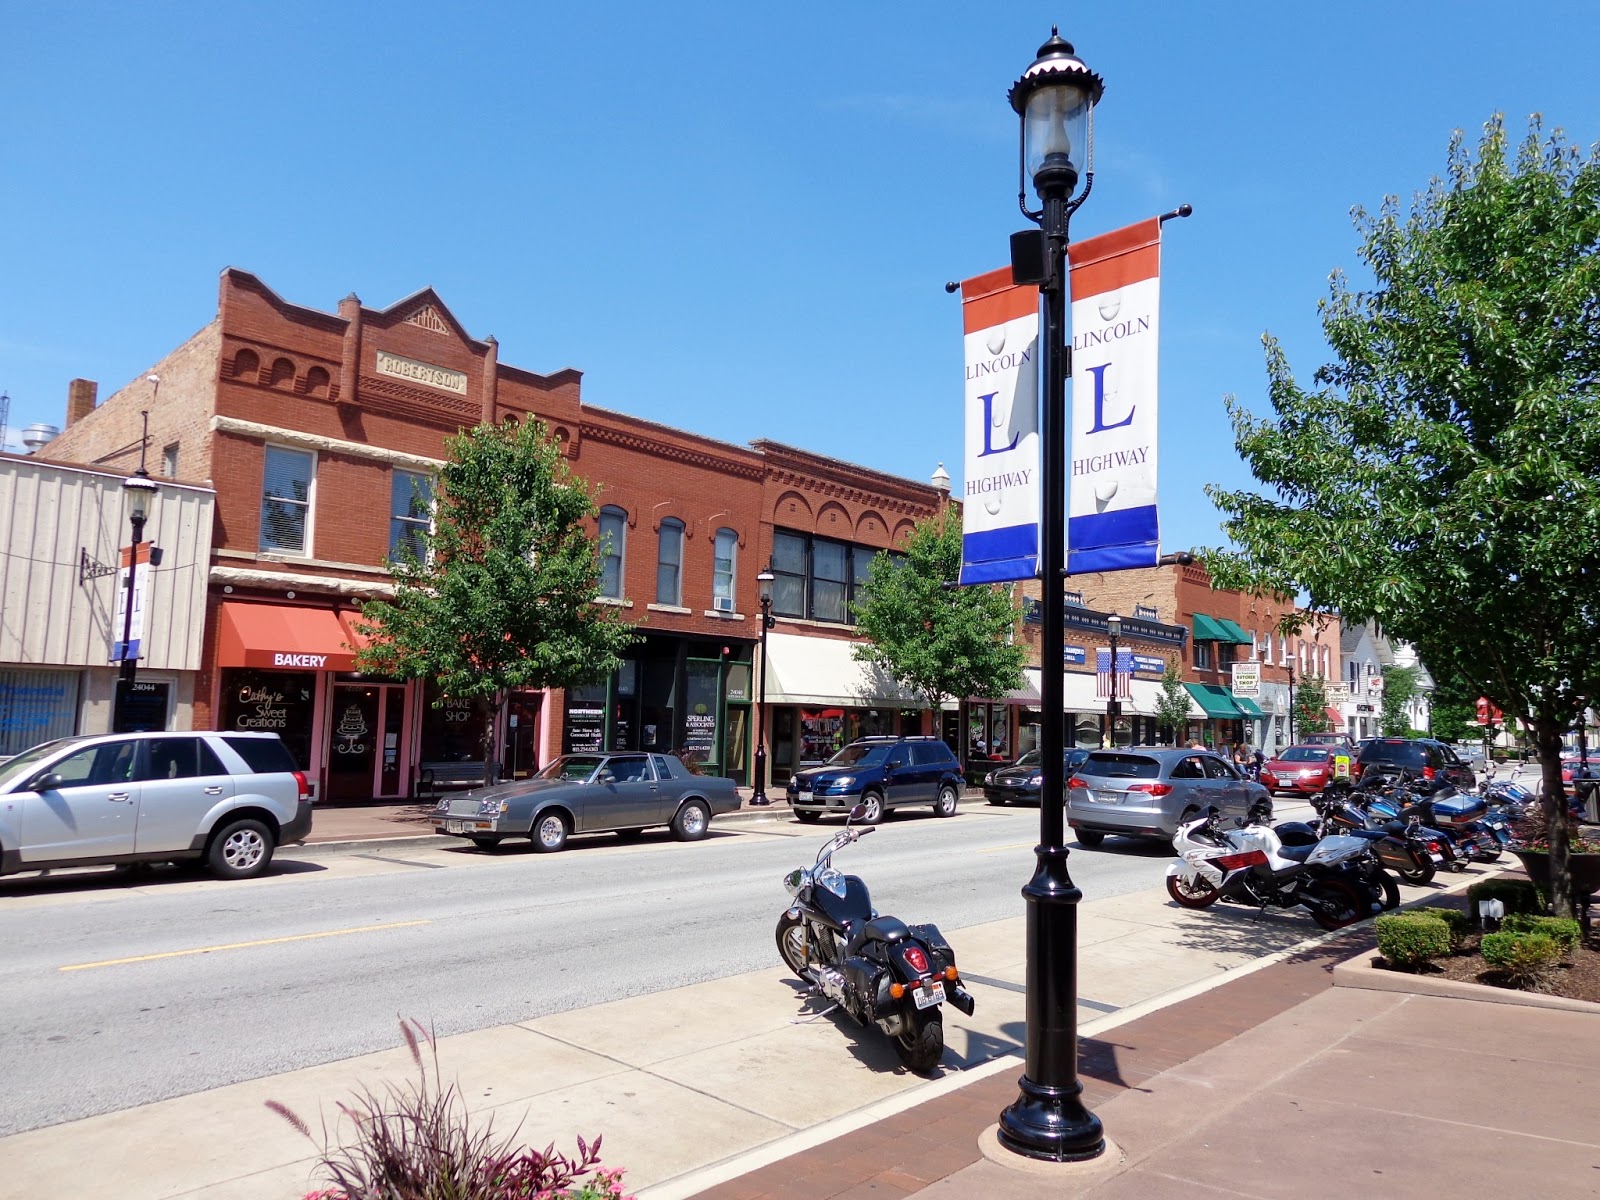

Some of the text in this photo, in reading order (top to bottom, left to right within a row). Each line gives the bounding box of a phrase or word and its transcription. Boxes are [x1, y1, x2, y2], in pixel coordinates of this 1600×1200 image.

[1073, 314, 1151, 352] LINCOLN
[384, 356, 460, 390] ROBERTSON
[966, 348, 1032, 381] LINCOLN
[1085, 362, 1136, 435] L
[977, 391, 1020, 458] L
[1073, 446, 1150, 476] HIGHWAY
[966, 469, 1032, 496] HIGHWAY
[274, 653, 327, 667] BAKERY
[131, 683, 156, 692] 24044
[239, 685, 284, 709] Cathy's
[255, 704, 287, 718] Sweet
[445, 710, 471, 722] SHOP
[446, 699, 471, 709] BAKE
[236, 714, 286, 728] Creations
